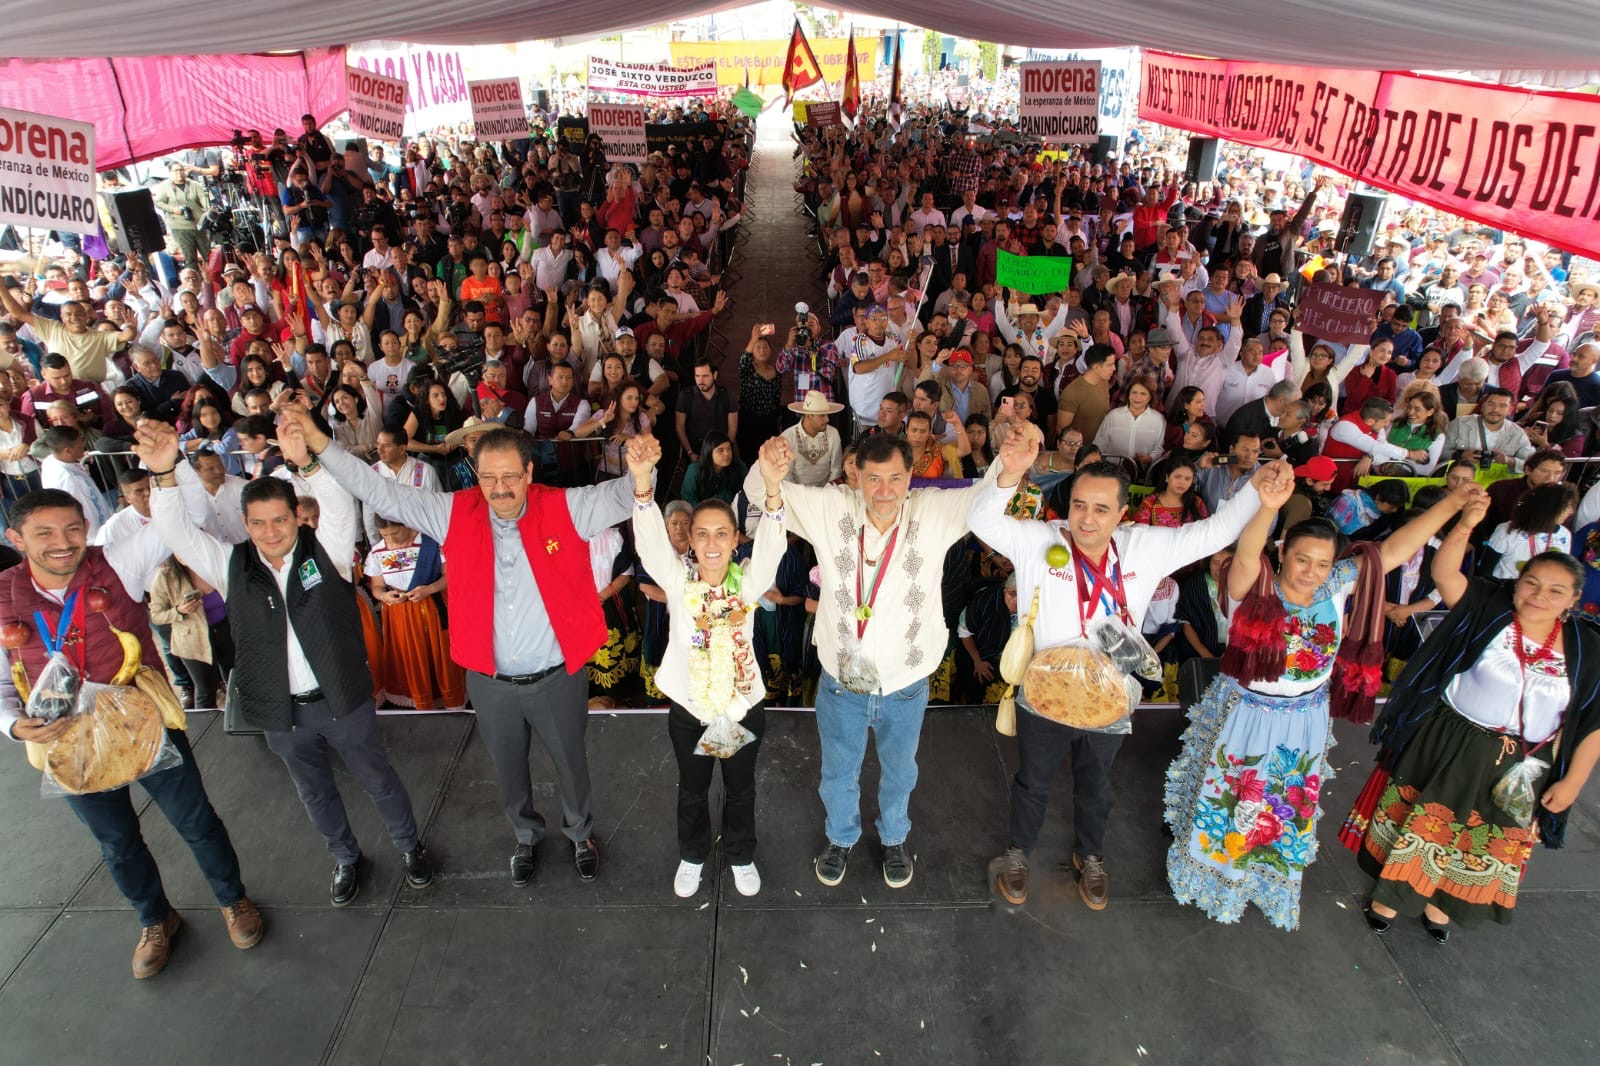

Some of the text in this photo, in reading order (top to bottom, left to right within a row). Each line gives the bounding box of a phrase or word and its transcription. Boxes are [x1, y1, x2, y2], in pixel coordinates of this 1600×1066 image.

[615, 62, 655, 71] CLAUDIA
[720, 57, 732, 68] EL
[411, 52, 428, 110] X
[621, 71, 652, 82] SIXTO
[655, 72, 713, 83] VERDUZCO
[1024, 67, 1096, 93] morena
[349, 73, 403, 105] morena
[471, 82, 520, 104] morena
[1024, 95, 1096, 108] La esperanza de México
[591, 108, 643, 127] morena
[1021, 111, 1098, 136] PANINDÍCUARO
[1146, 63, 1161, 108] NO
[1161, 65, 1173, 114] SE
[1175, 69, 1207, 123] TRATA
[1207, 74, 1225, 127] DE
[1304, 81, 1339, 154] SE
[1332, 93, 1418, 185] TRATA
[1409, 109, 1462, 192] DE
[1453, 117, 1534, 209] LOS
[35, 162, 49, 177] de
[52, 164, 89, 183] México
[546, 541, 559, 555] PT
[1048, 567, 1073, 582] Celis
